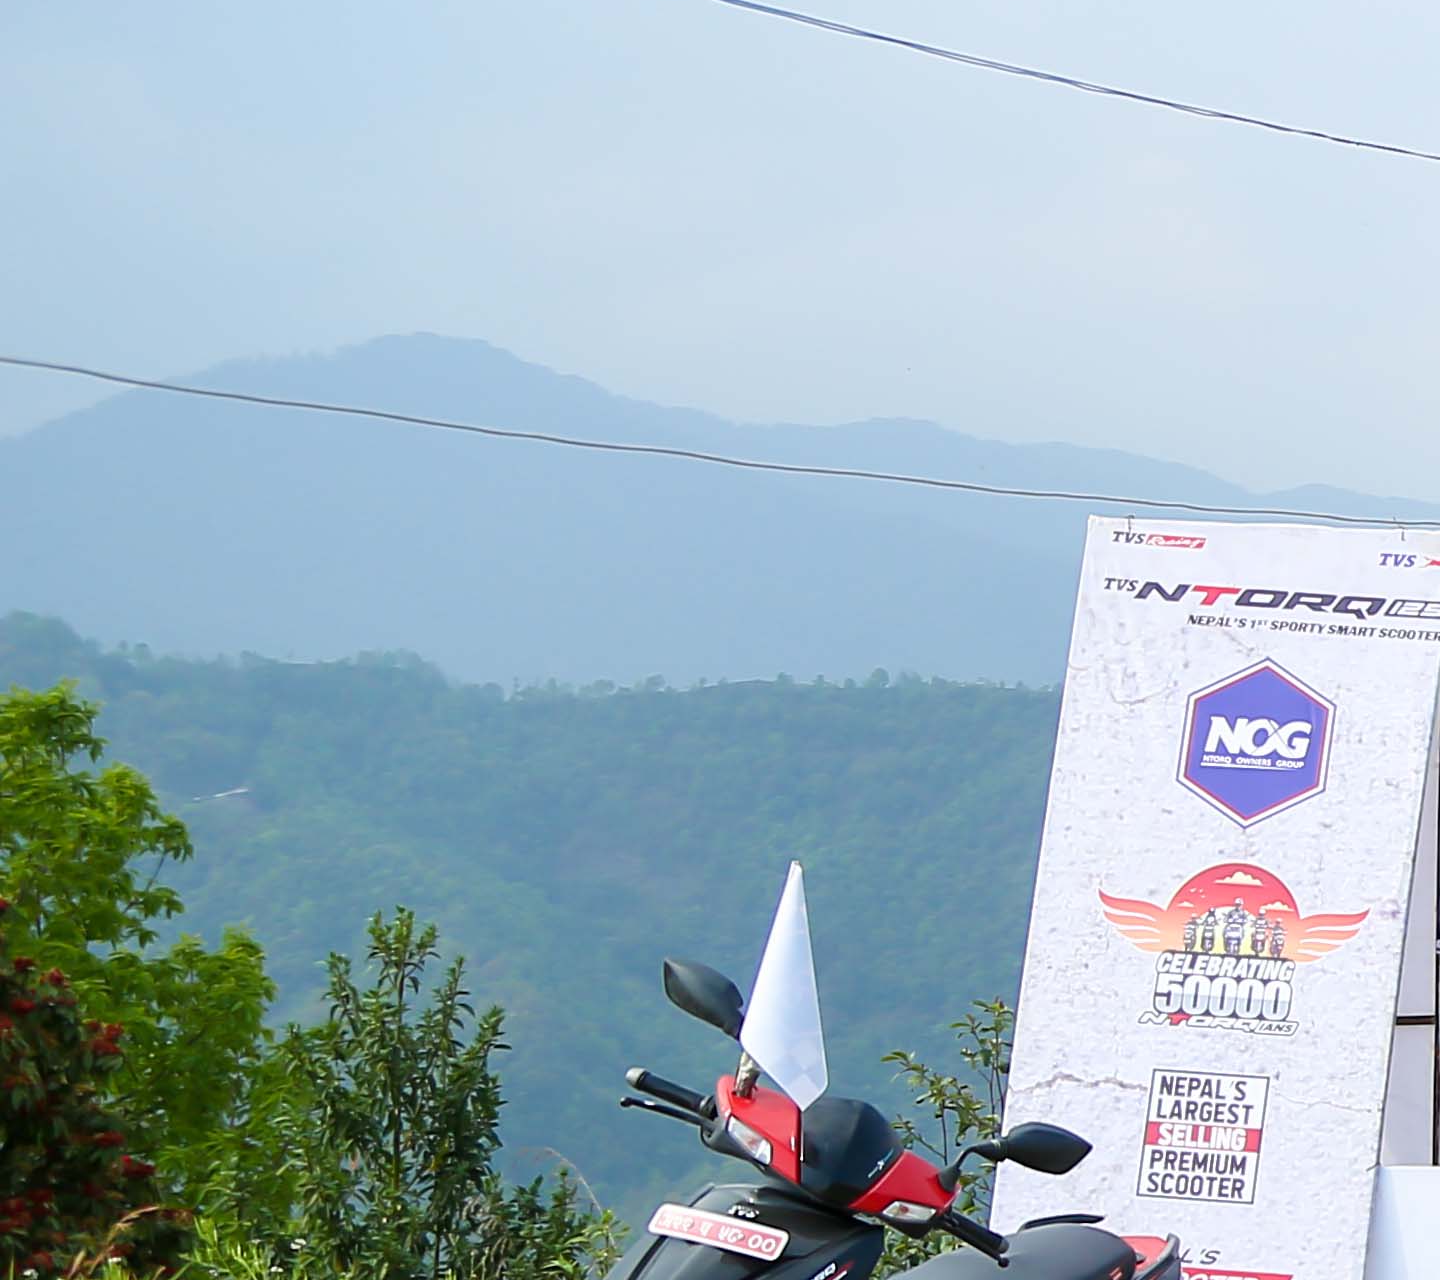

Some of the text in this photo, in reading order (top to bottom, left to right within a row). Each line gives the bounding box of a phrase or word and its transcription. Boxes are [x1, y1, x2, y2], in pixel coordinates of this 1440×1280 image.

[1112, 531, 1146, 544] TVS
[1379, 553, 1417, 568] TVS
[1104, 578, 1138, 592] TVS
[1134, 581, 1387, 620] NTORQ
[1187, 614, 1247, 629] NEPAL'S
[1270, 620, 1326, 634] SPORTY
[1327, 624, 1377, 638] SMART
[1204, 716, 1312, 759] NOG
[1276, 760, 1304, 769] GROUP
[1157, 952, 1295, 981] CELEBRATING
[1155, 973, 1292, 1021] 50000
[1159, 1075, 1248, 1101] NEPAL'S
[1157, 1098, 1254, 1125] LARGEST
[1157, 1123, 1247, 1152] SELLING
[1150, 1149, 1247, 1176] PREMIUM
[1147, 1172, 1245, 1199] SCOOTER
